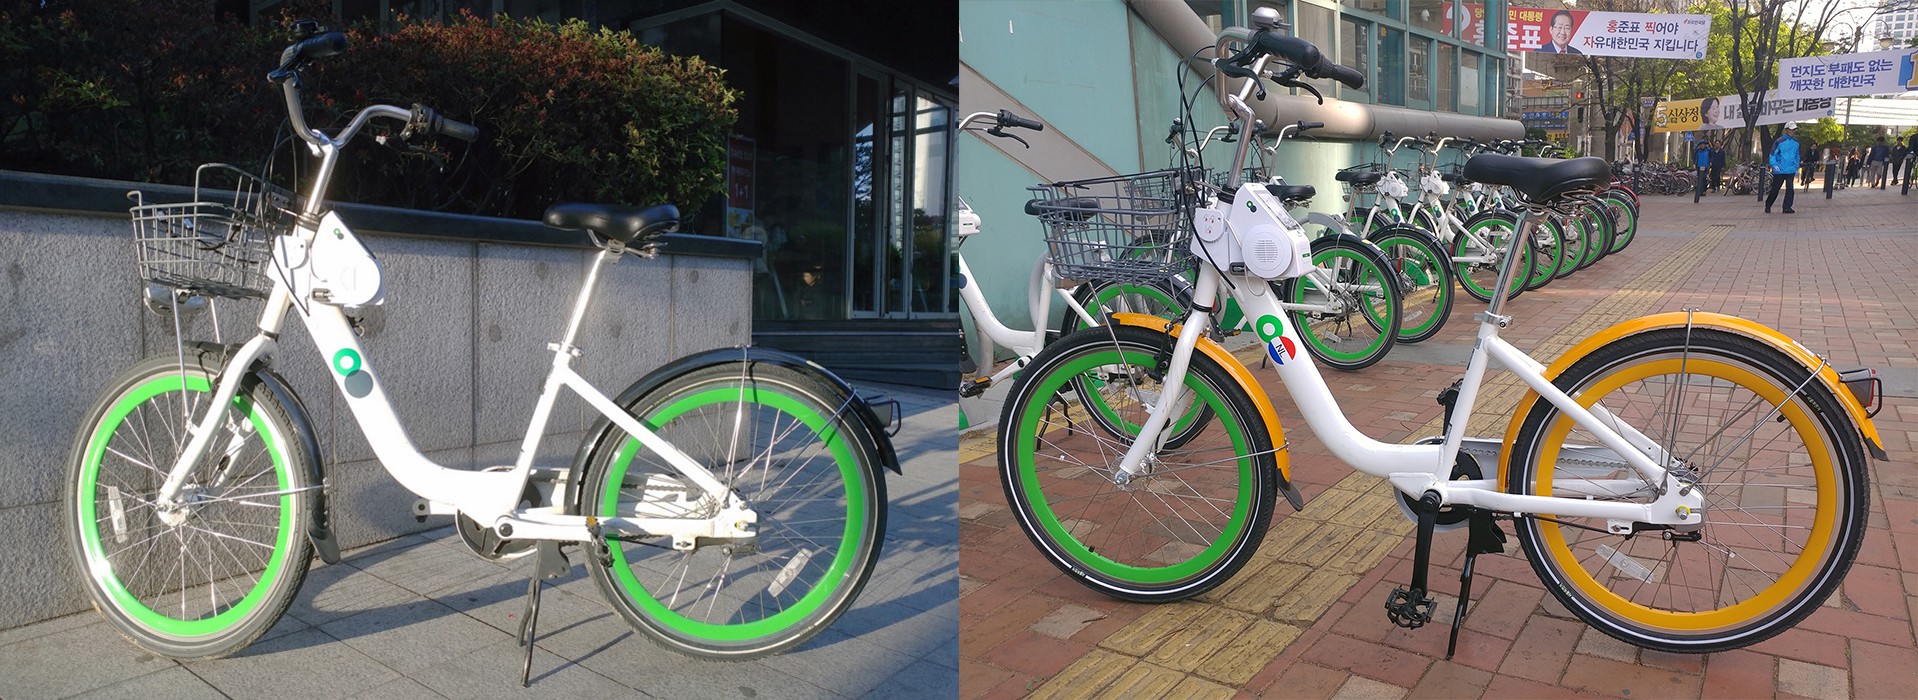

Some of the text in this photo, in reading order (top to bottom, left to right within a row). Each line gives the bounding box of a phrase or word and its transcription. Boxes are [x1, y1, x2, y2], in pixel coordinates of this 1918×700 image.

[1520, 10, 1543, 22] 대통령
[1607, 20, 1679, 35] 홍준표 찍어야
[1583, 36, 1698, 52] 자유대한민국 지킵니다
[1791, 59, 1893, 78] 먼지도 부패도 없는
[1789, 74, 1876, 91] 깨끗한 대한민국
[1655, 106, 1668, 128] 5
[1668, 106, 1699, 123] 심상정
[1723, 105, 1735, 120] 내
[1275, 343, 1286, 358] NL
